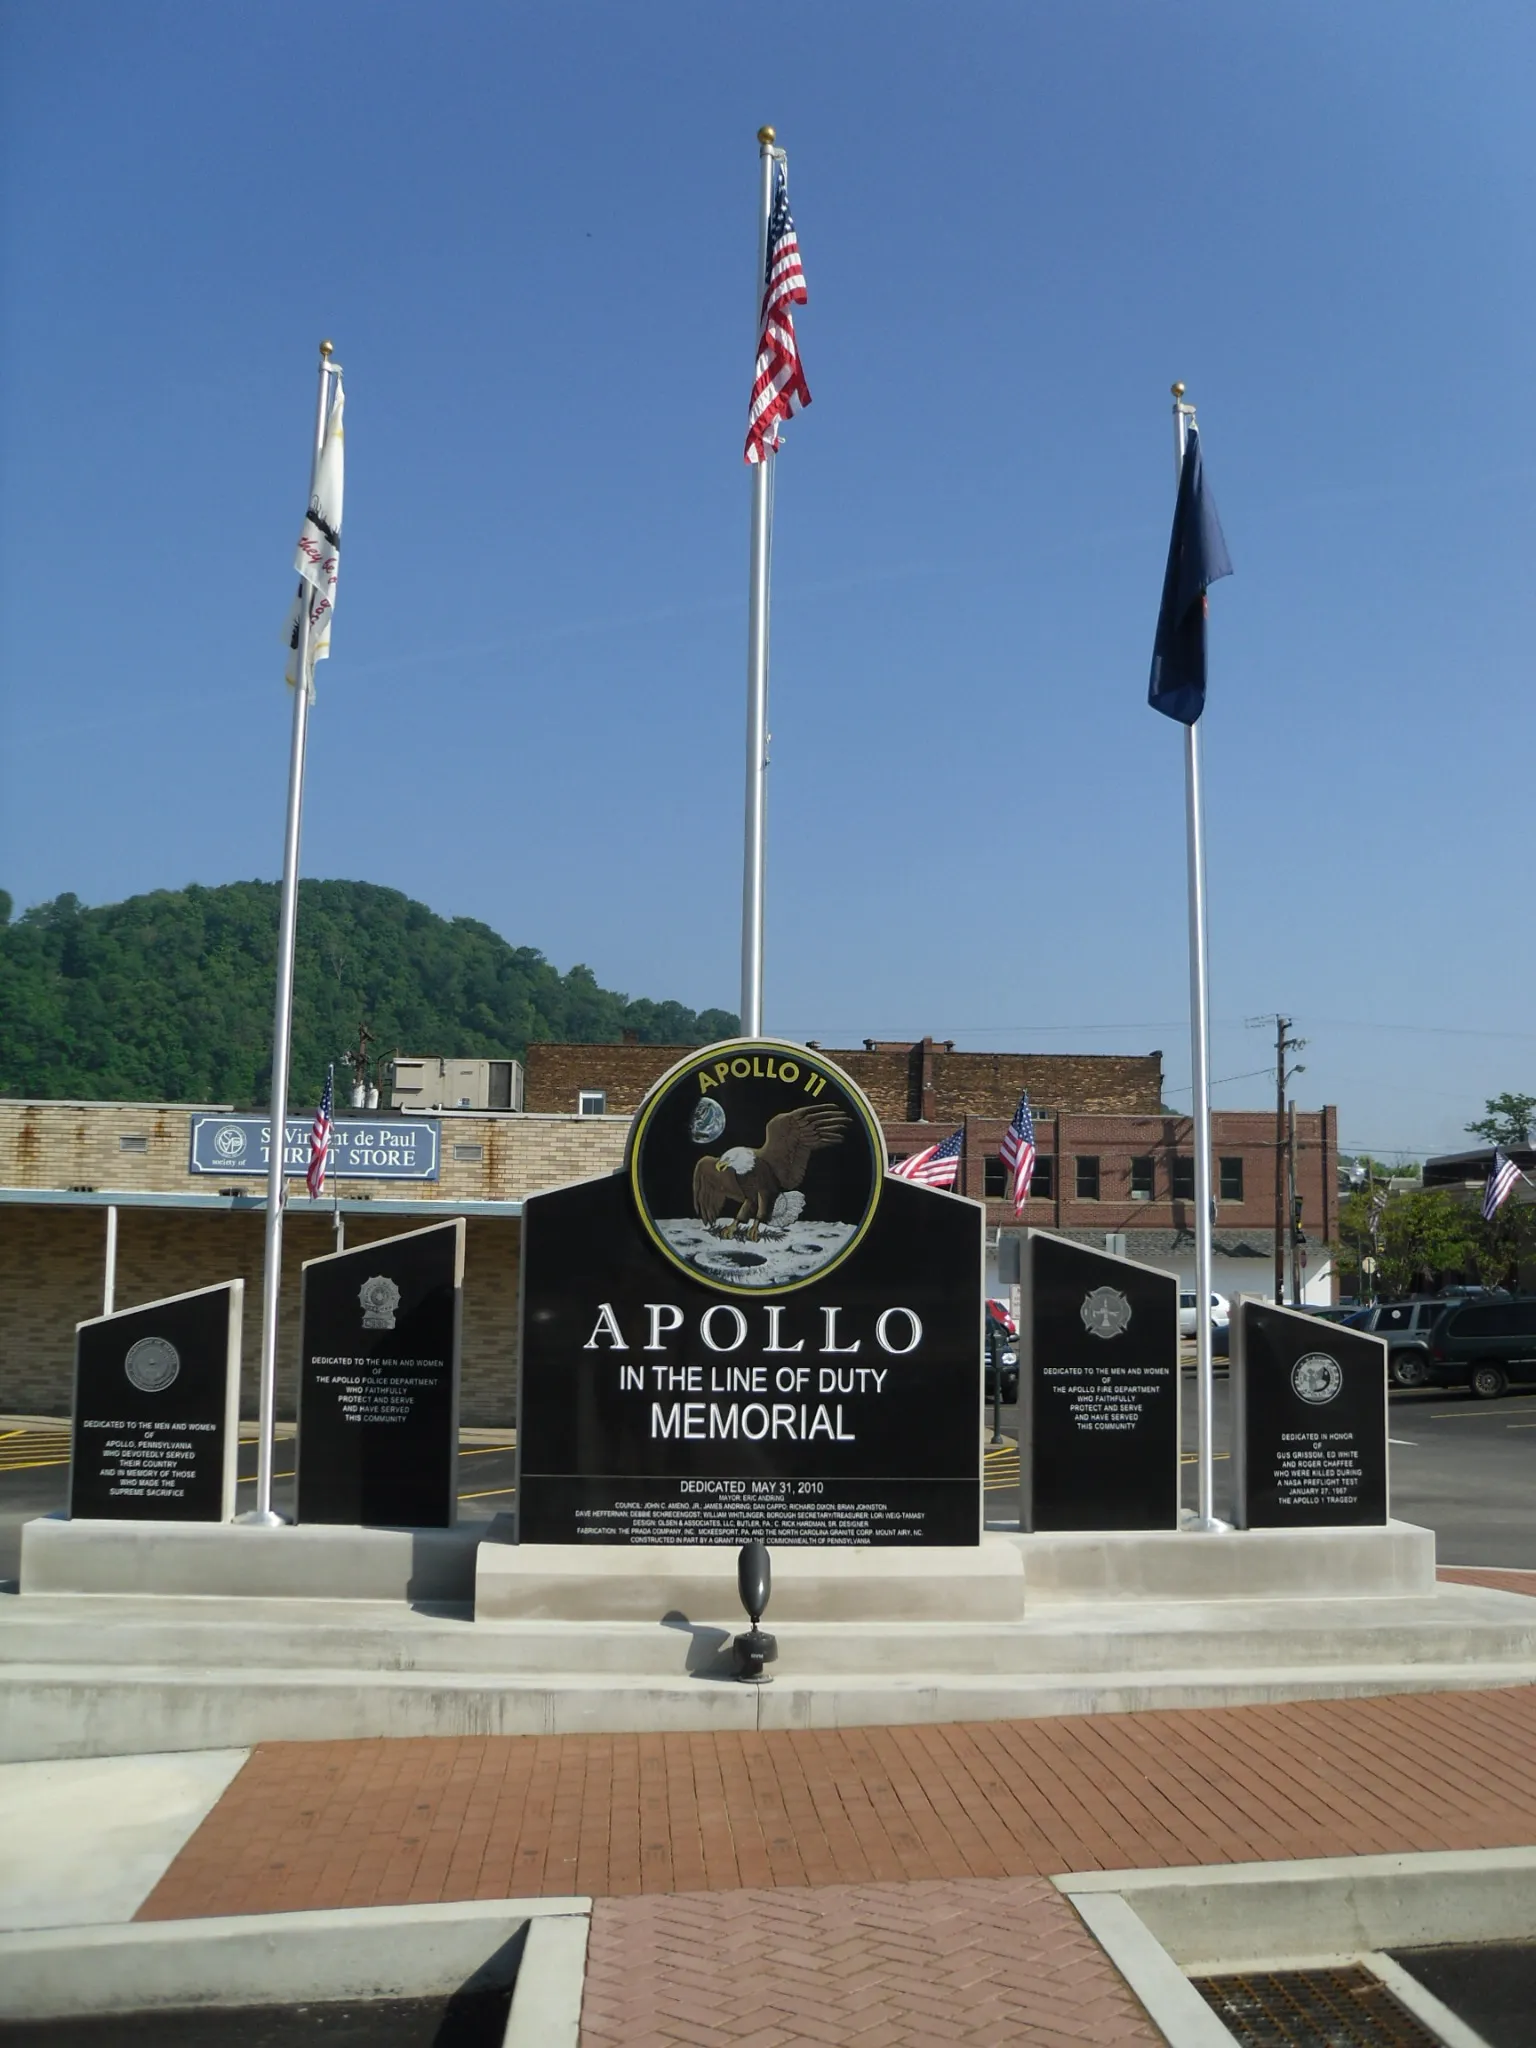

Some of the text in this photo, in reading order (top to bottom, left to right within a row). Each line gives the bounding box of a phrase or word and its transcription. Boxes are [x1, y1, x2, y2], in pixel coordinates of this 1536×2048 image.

[698, 1057, 827, 1098] APOLLO 11
[355, 1129, 374, 1146] de
[379, 1130, 416, 1147] Paul
[350, 1150, 416, 1166] STORE
[583, 1302, 924, 1354] APOLLO
[312, 1357, 352, 1365] DEDICATED
[620, 1365, 888, 1394] IN THE LINE OF DUTY
[84, 1420, 124, 1428] DEDICATED
[189, 1423, 215, 1431] WOMEN
[651, 1402, 856, 1440] MEMORIAL
[139, 1441, 192, 1449] PENNSYLVANIA
[681, 1480, 824, 1495] DEDICATED MAY 31, 2010
[703, 1502, 722, 1510] JAMES
